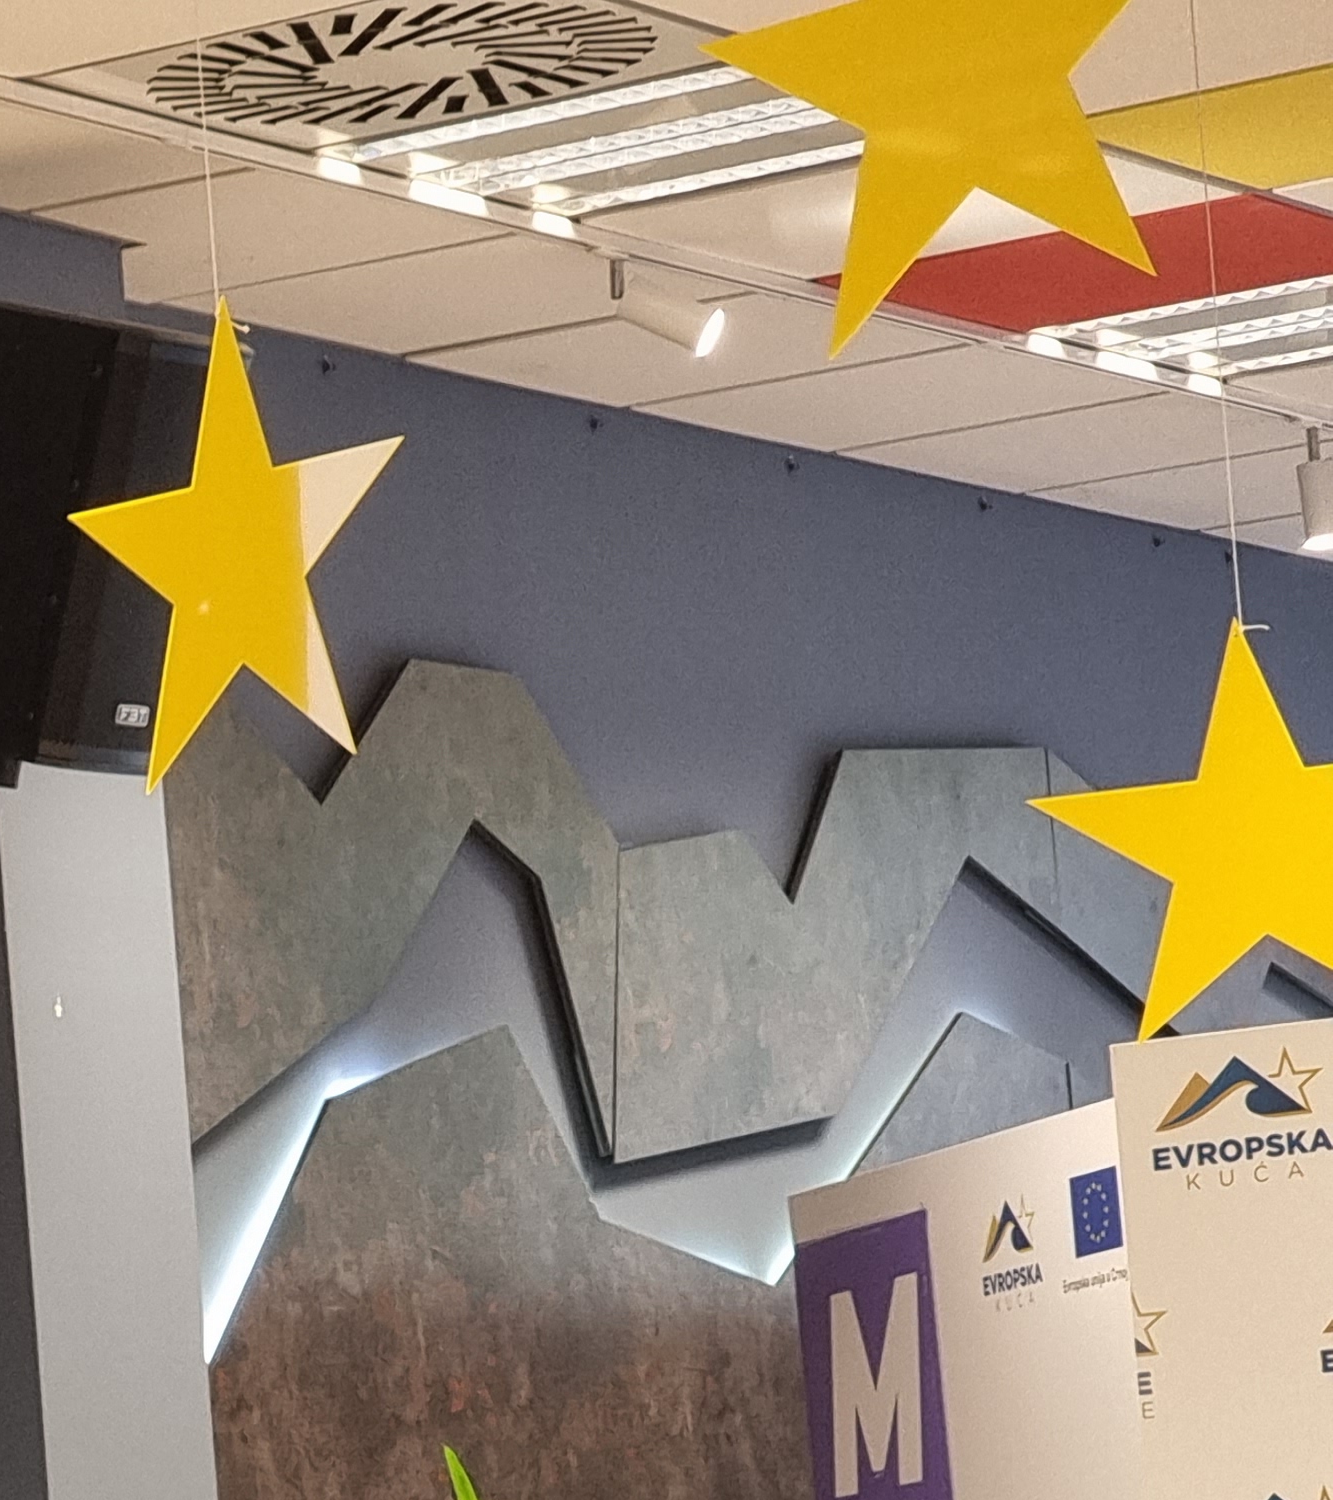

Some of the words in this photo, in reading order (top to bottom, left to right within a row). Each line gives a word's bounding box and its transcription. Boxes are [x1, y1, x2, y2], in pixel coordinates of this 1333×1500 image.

[1152, 1128, 1333, 1171] EVROPSKA
[982, 1262, 1044, 1297] EVROPSKA
[829, 1271, 923, 1498] M
